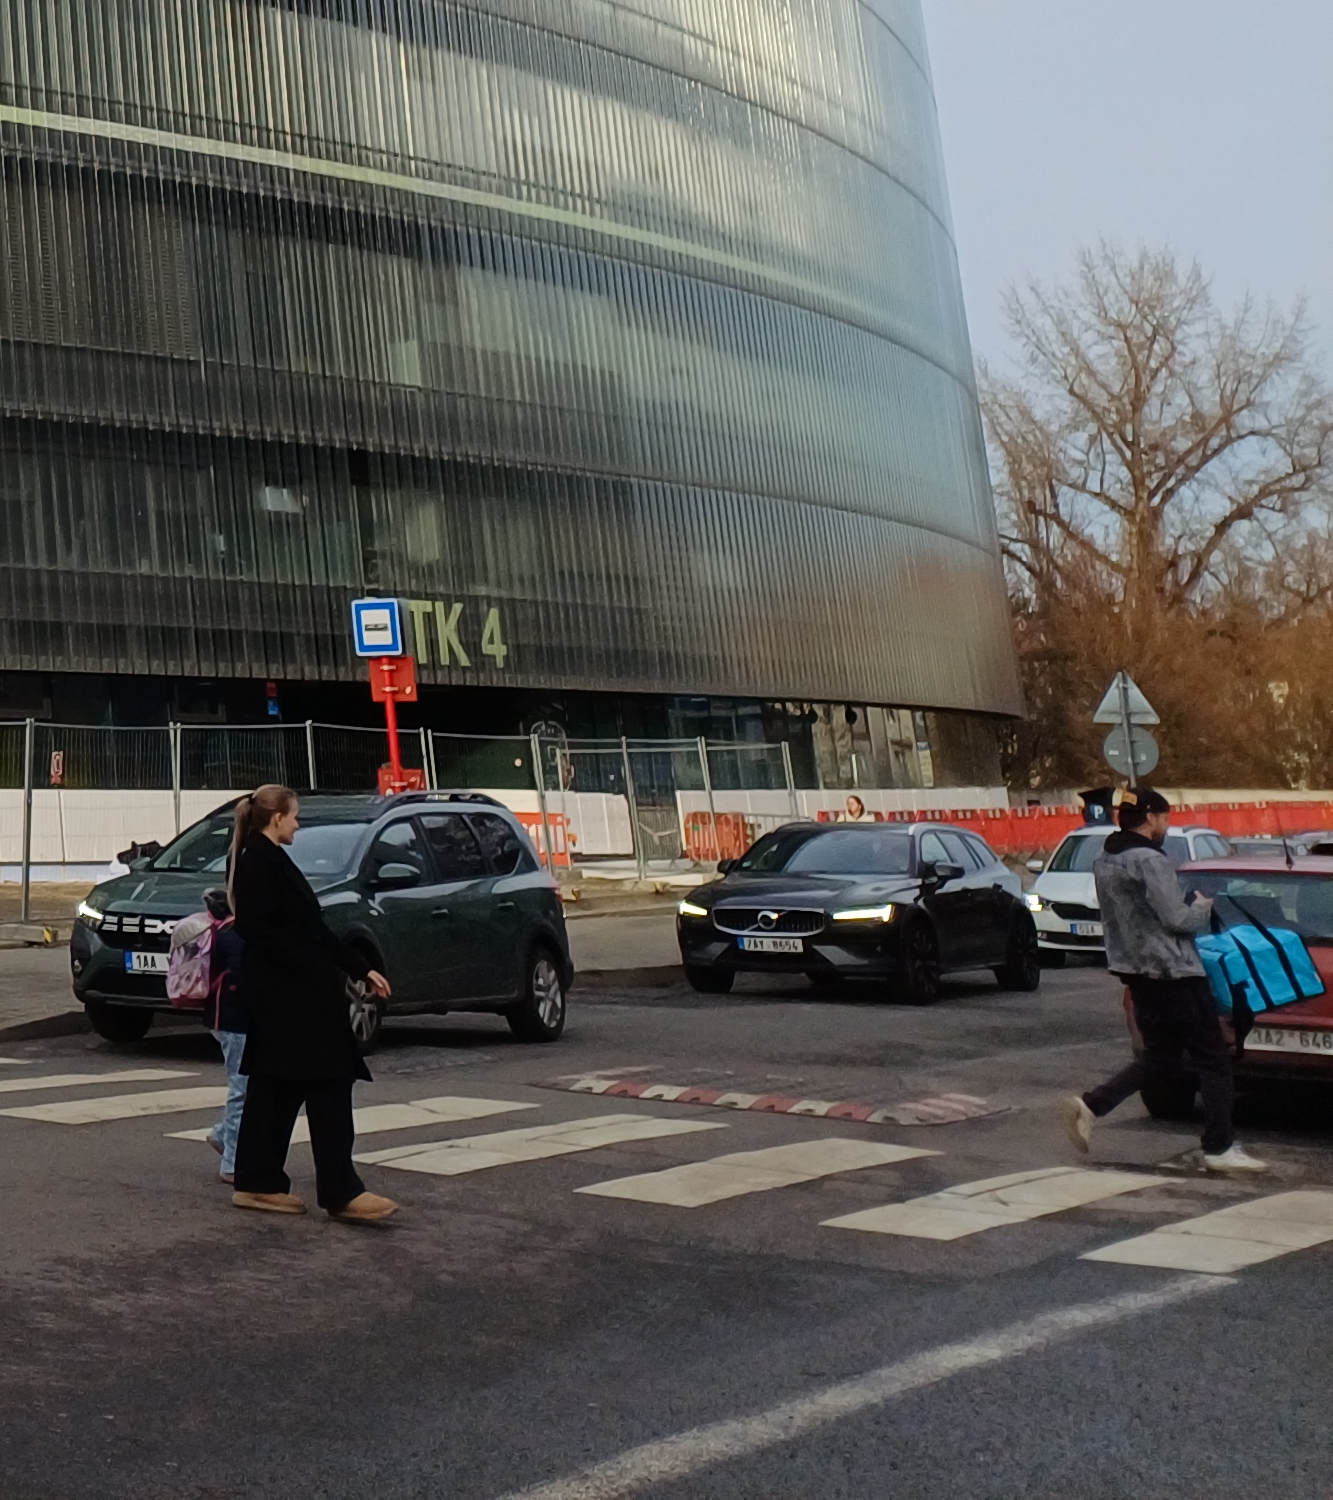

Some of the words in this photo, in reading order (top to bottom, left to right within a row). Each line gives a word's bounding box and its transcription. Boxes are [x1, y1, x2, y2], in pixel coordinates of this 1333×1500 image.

[482, 607, 508, 669] 4
[1094, 804, 1104, 820] P
[135, 954, 158, 969] 1AA
